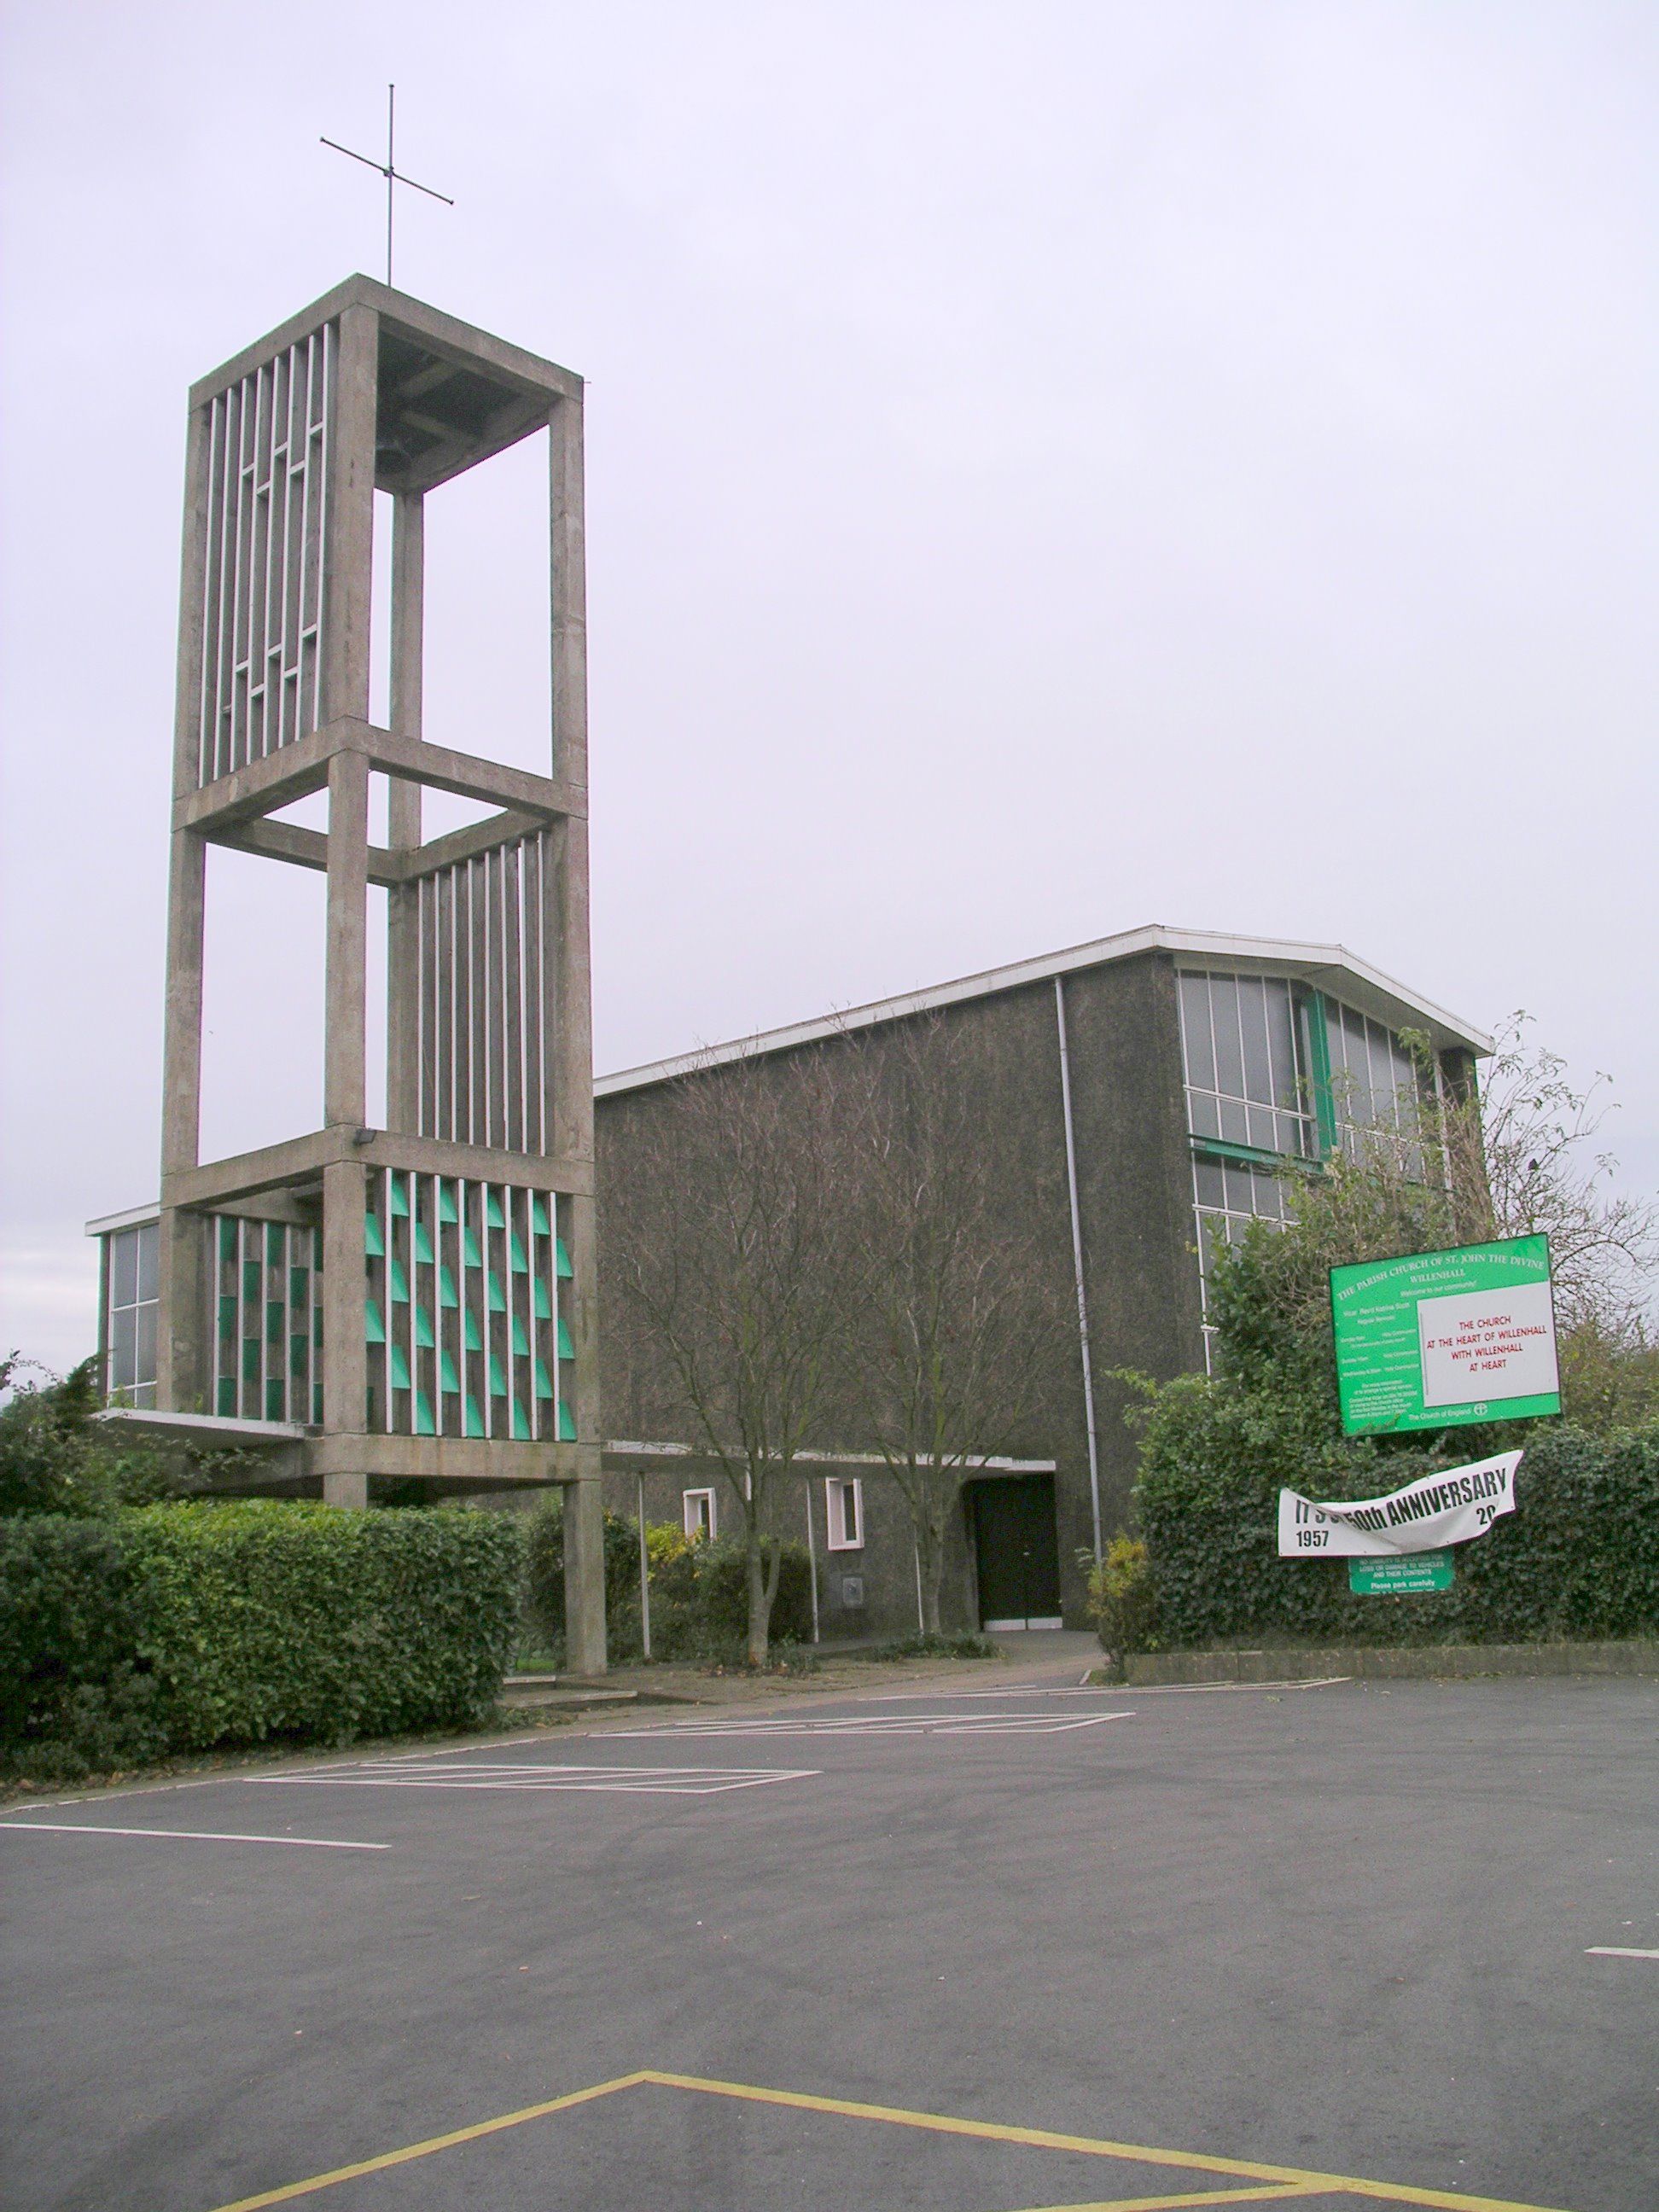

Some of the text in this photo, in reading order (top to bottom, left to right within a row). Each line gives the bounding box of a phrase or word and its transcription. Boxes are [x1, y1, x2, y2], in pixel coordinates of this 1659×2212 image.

[1337, 1286, 1355, 1301] THE
[1356, 1271, 1388, 1290] PARISH
[1389, 1259, 1429, 1277] CHURCH
[1430, 1256, 1443, 1266] OF
[1461, 1254, 1486, 1264] JOHN
[1488, 1254, 1508, 1264] THE
[1511, 1256, 1545, 1270] DIVINE
[1410, 1268, 1466, 1283] WILLENHALL
[1459, 1315, 1511, 1330] THE CHURCH
[1427, 1325, 1546, 1349] AT THE HEART OF WILLENHALL
[1451, 1342, 1523, 1360] WITH WILLENHALL
[1470, 1359, 1507, 1372] AT HEART
[1420, 1412, 1441, 1420] Church
[1343, 1506, 1388, 1531] 50th
[1386, 1468, 1506, 1527] ANNIVERSARY
[1296, 1530, 1329, 1547] 1957
[1393, 1581, 1406, 1590] park
